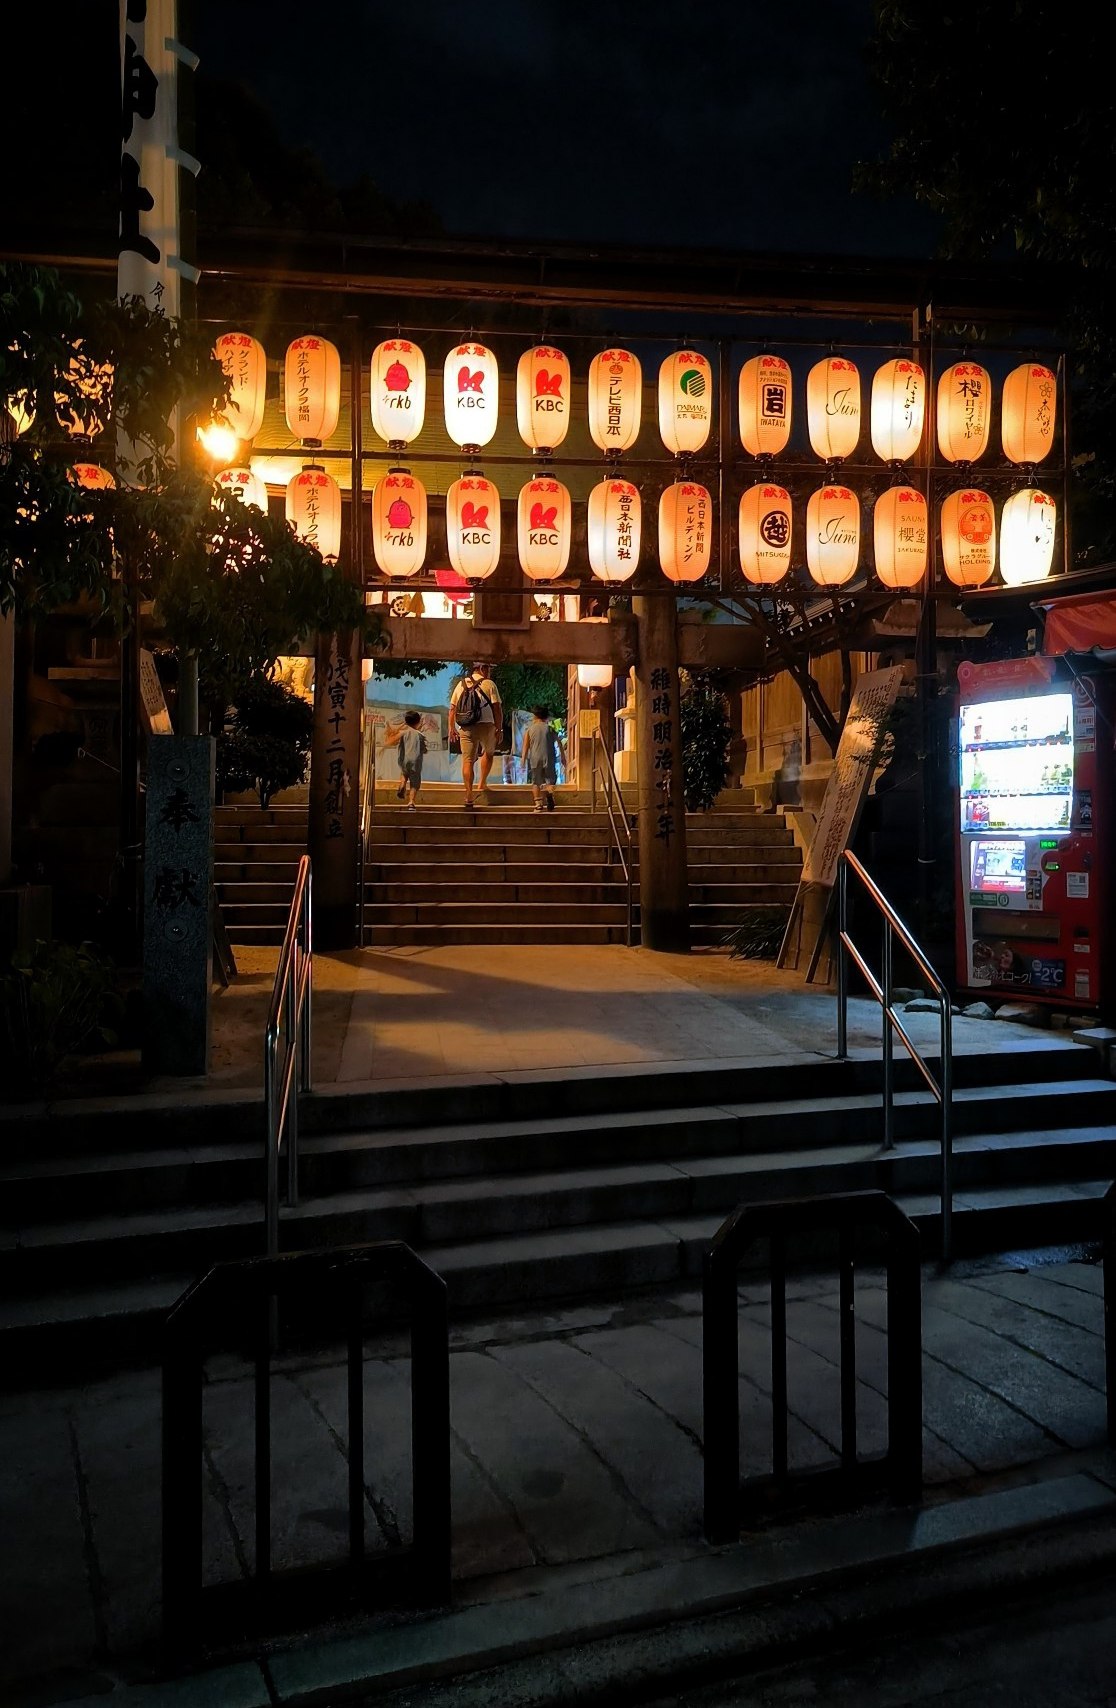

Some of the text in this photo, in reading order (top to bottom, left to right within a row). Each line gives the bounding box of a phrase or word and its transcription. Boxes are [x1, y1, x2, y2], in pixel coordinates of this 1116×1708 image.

[297, 351, 309, 423] ホテルオークラ福岡
[457, 397, 485, 409] KBC
[535, 401, 564, 412] KBC
[607, 377, 622, 436] テレビ西日本
[760, 419, 786, 428] IWATAYA
[617, 495, 633, 560] 西日本新聞社
[695, 499, 705, 553] 西日本新聞
[462, 533, 490, 544] KBC
[530, 533, 558, 545] KBC
